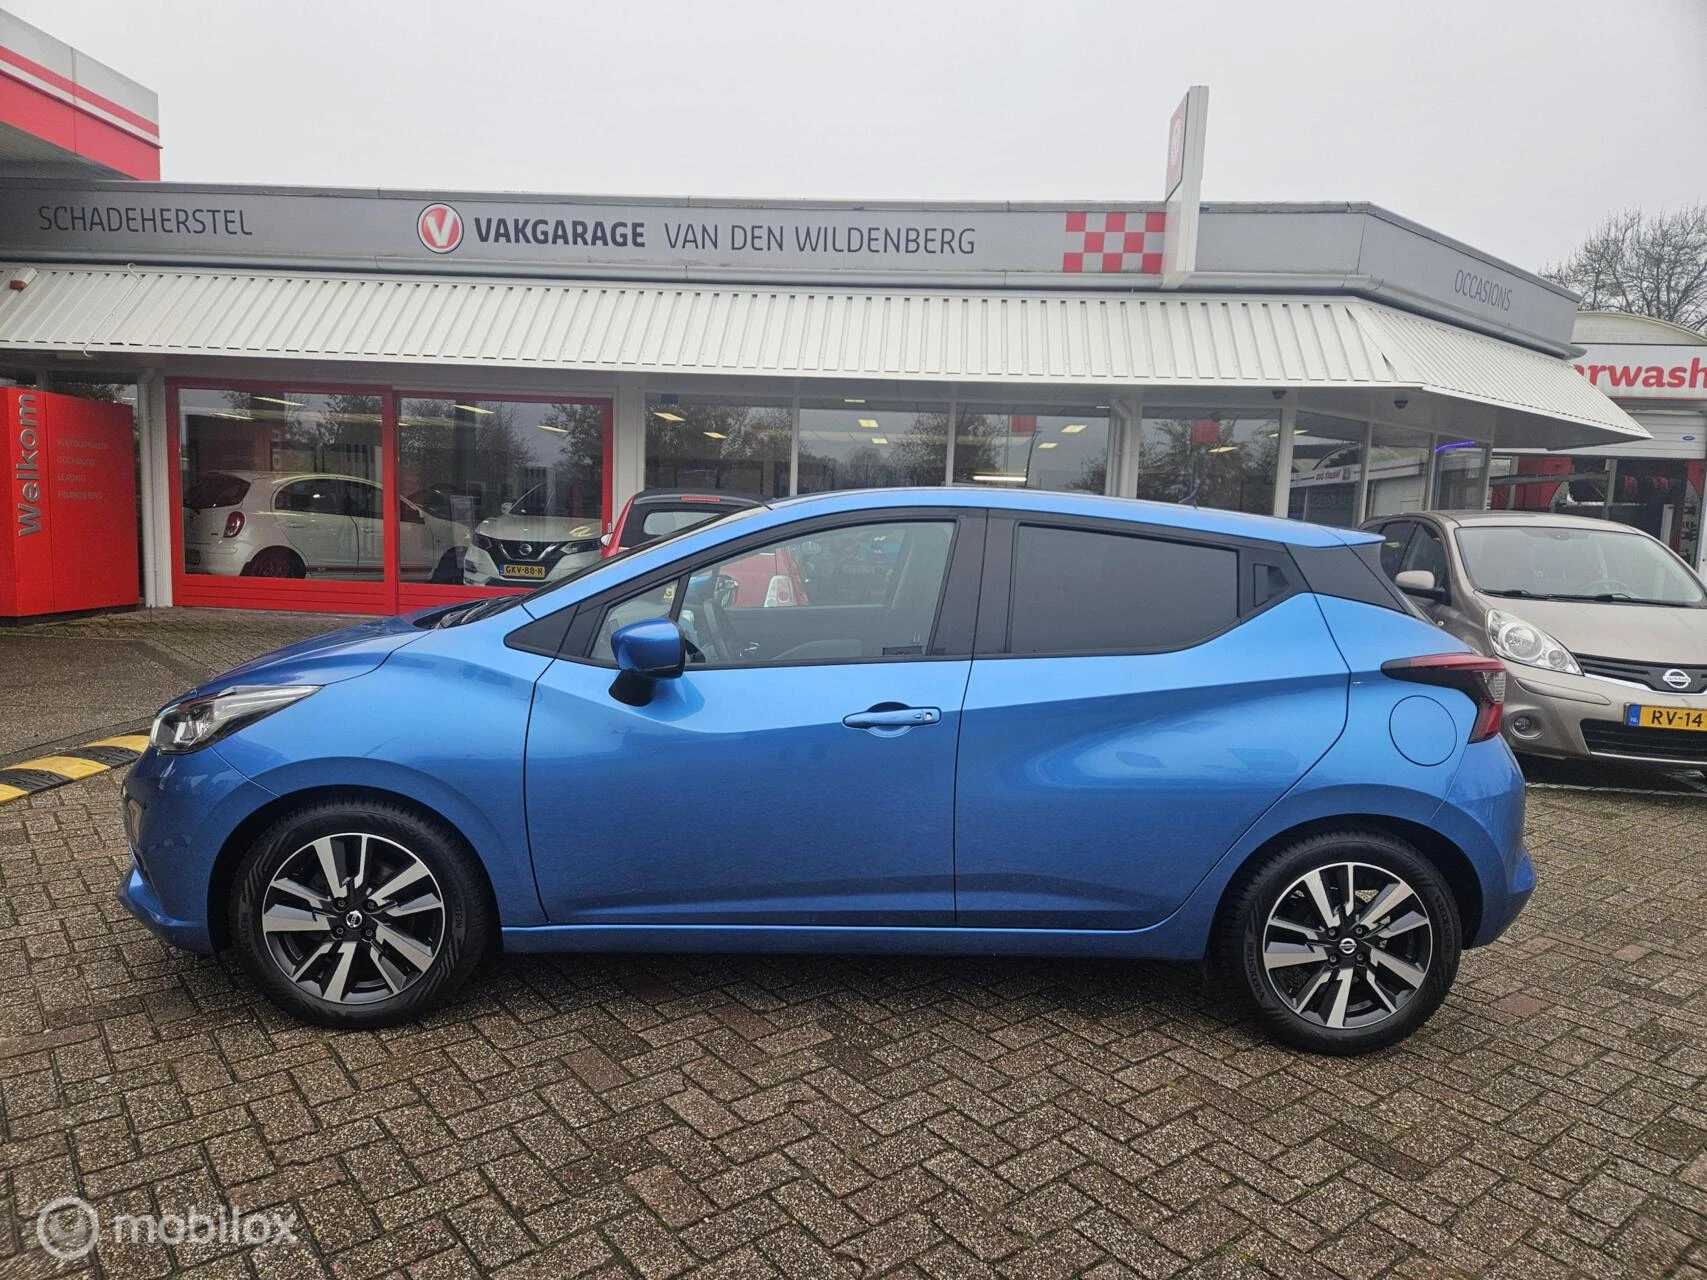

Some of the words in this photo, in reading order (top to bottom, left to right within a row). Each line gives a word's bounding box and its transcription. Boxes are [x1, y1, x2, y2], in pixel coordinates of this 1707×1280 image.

[39, 205, 253, 236] SCHADEHERSTEL
[474, 217, 646, 248] VAKGARAGE
[664, 223, 718, 250] VAN
[731, 224, 784, 252] DEN
[795, 226, 976, 254] WILDENBERG
[1454, 269, 1513, 311] OCCASIONS
[16, 393, 42, 537] Welkom
[505, 565, 543, 576] GKV-88-R
